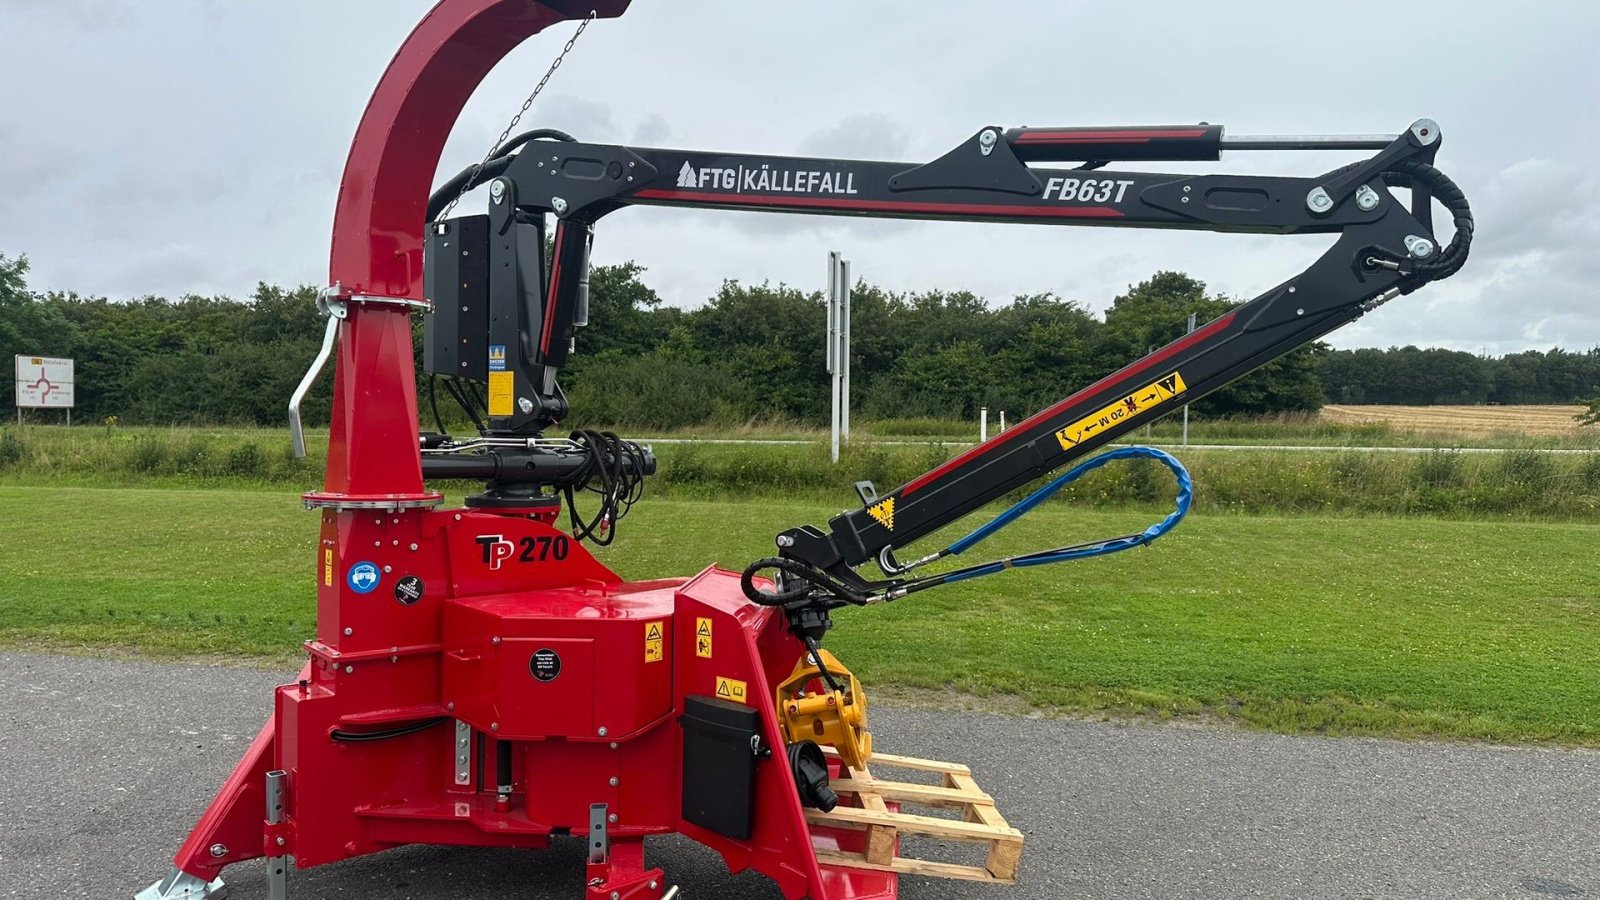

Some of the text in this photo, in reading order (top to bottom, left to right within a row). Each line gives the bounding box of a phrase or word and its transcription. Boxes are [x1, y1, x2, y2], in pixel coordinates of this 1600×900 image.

[698, 164, 858, 195] FTG KÄLLEFALL
[1042, 177, 1134, 203] FB63T
[1098, 408, 1124, 427] 20 M
[475, 534, 569, 571] TP 270
